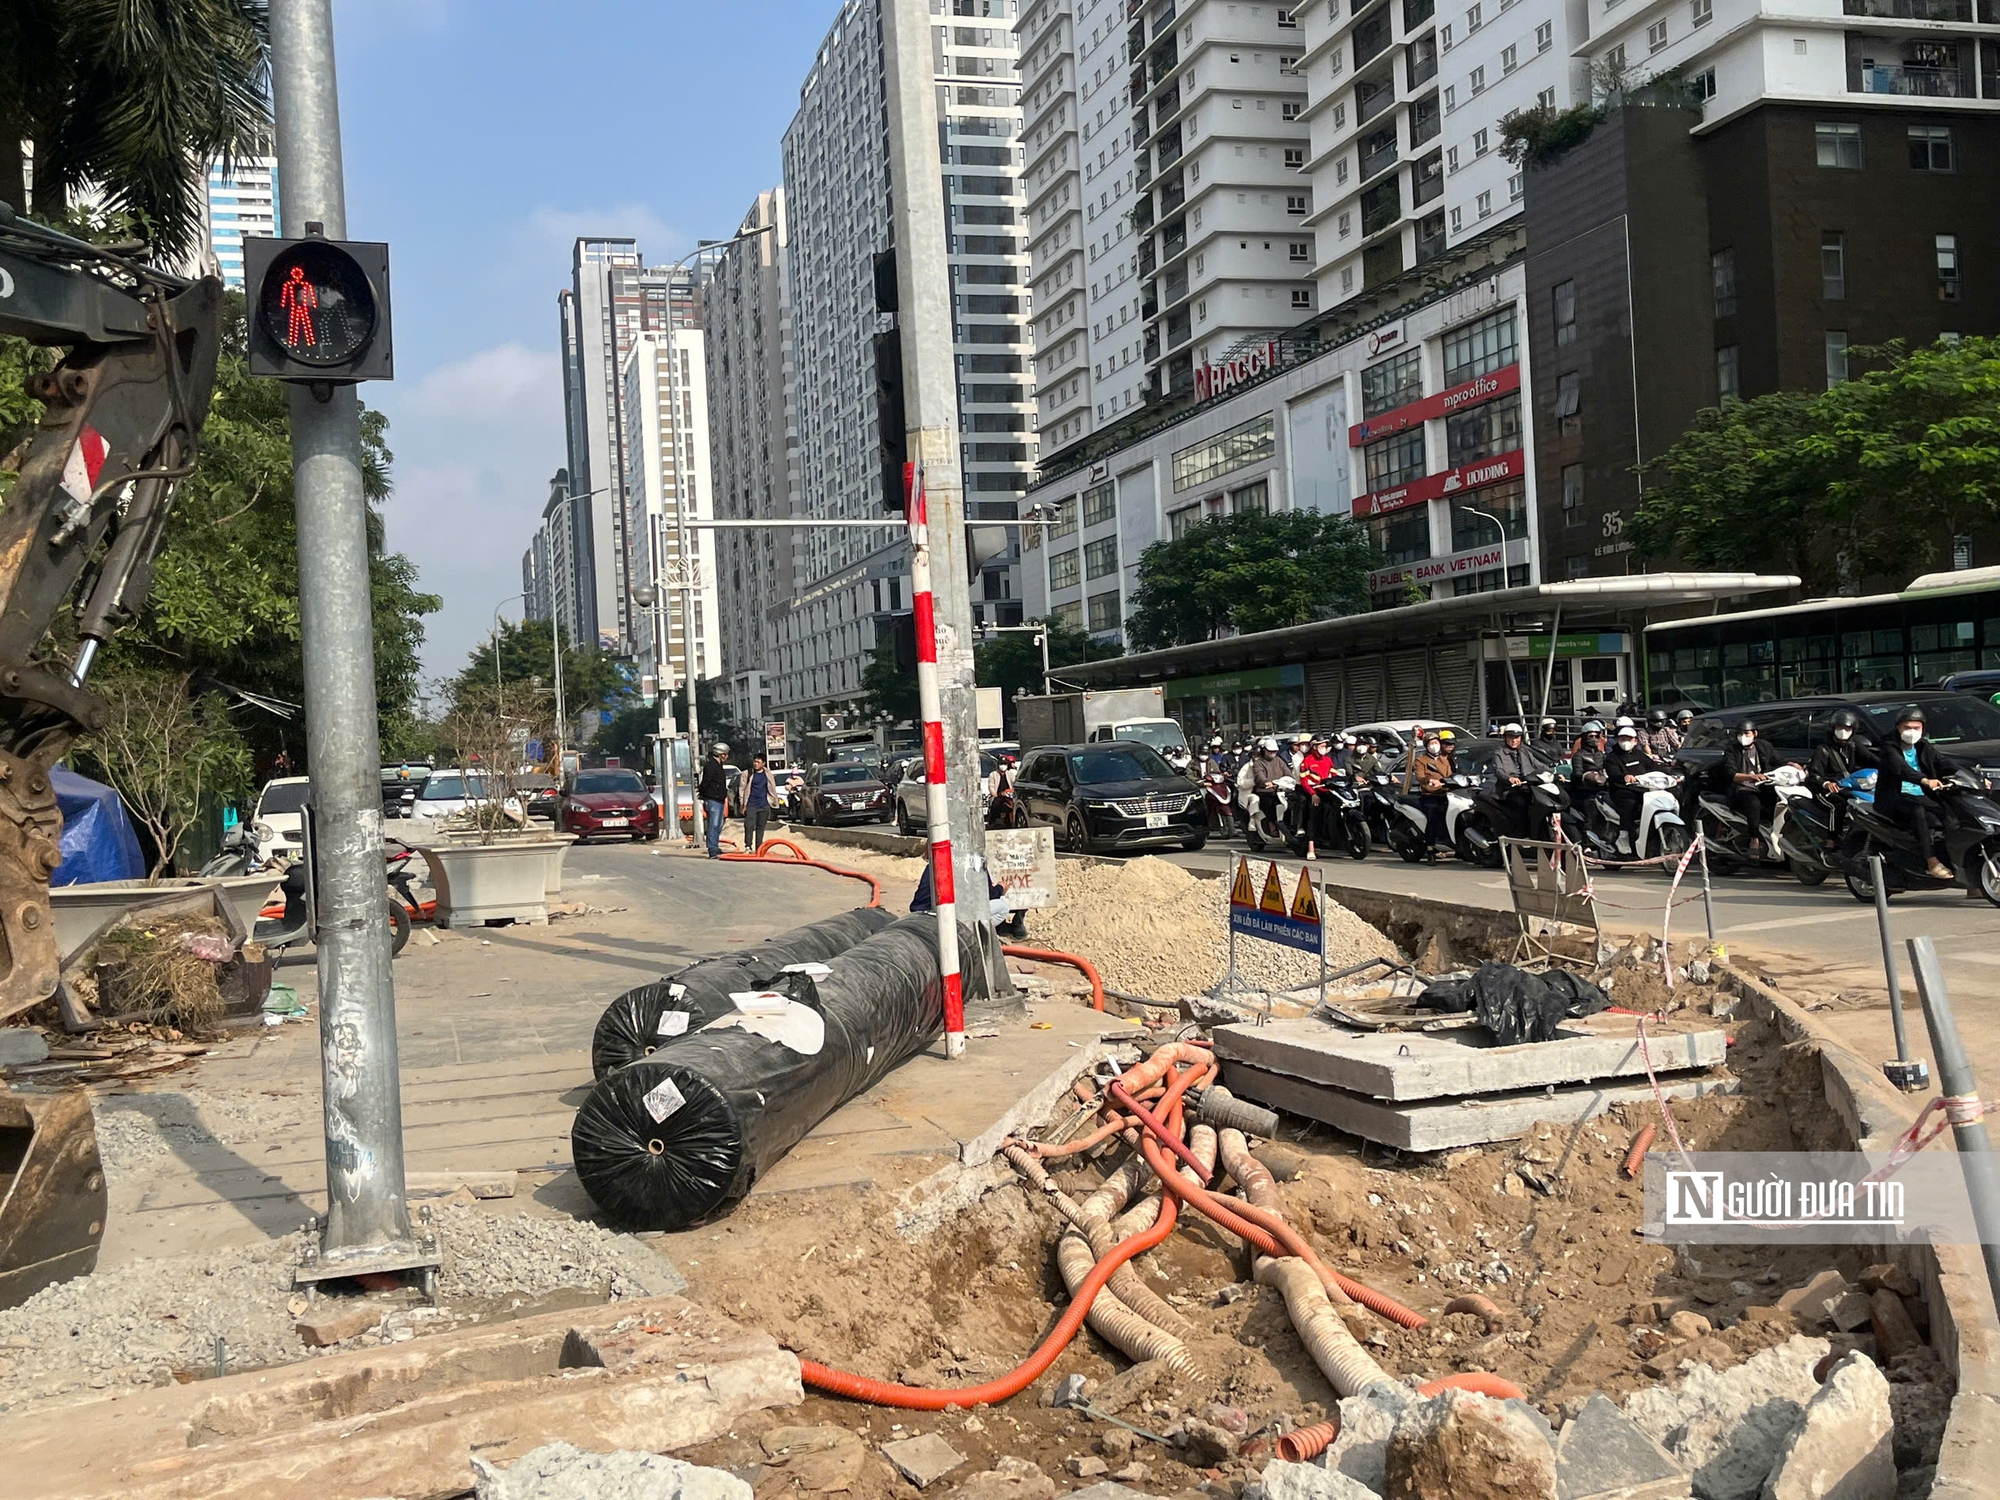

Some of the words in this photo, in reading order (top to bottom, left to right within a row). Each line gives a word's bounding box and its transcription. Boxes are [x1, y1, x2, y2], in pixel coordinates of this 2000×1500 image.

[1467, 462, 1508, 486] HOLDING
[1602, 510, 1623, 537] 35
[1381, 570, 1412, 586] PUBL
[1416, 563, 1445, 579] BANK
[1450, 551, 1501, 572] VIETNAM
[1233, 914, 1242, 924] XIN
[1291, 928, 1304, 940] CÁC
